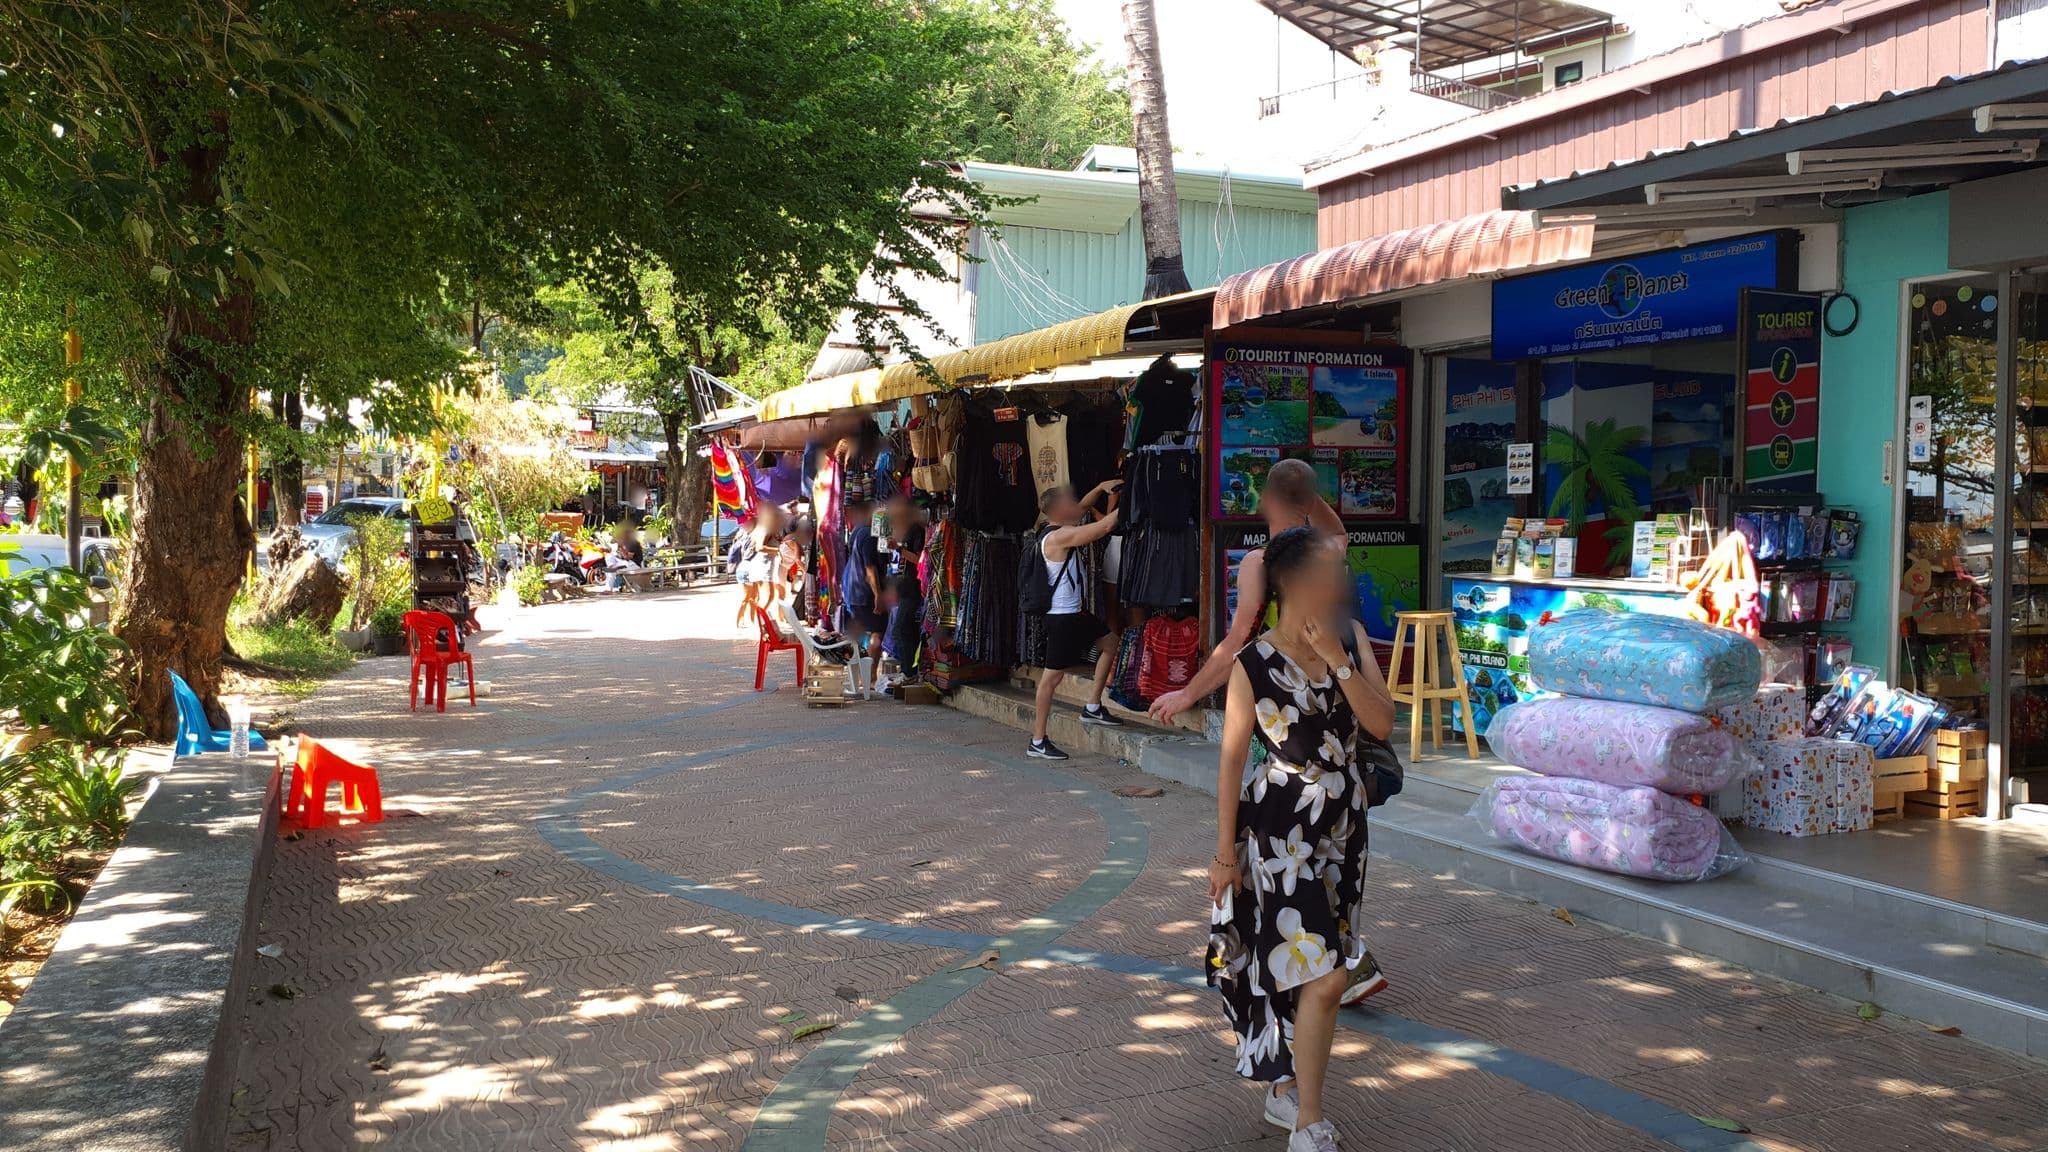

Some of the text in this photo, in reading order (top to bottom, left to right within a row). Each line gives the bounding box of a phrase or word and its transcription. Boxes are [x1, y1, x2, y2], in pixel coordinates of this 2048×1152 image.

[1555, 272, 1689, 309] Green Planet
[1757, 311, 1816, 329] TOURIST
[1238, 348, 1384, 367] TOURIST INFORMATION
[422, 499, 449, 519] 199
[1243, 531, 1406, 547] MAP FORMATION
[1481, 655, 1506, 667] ISLAND
